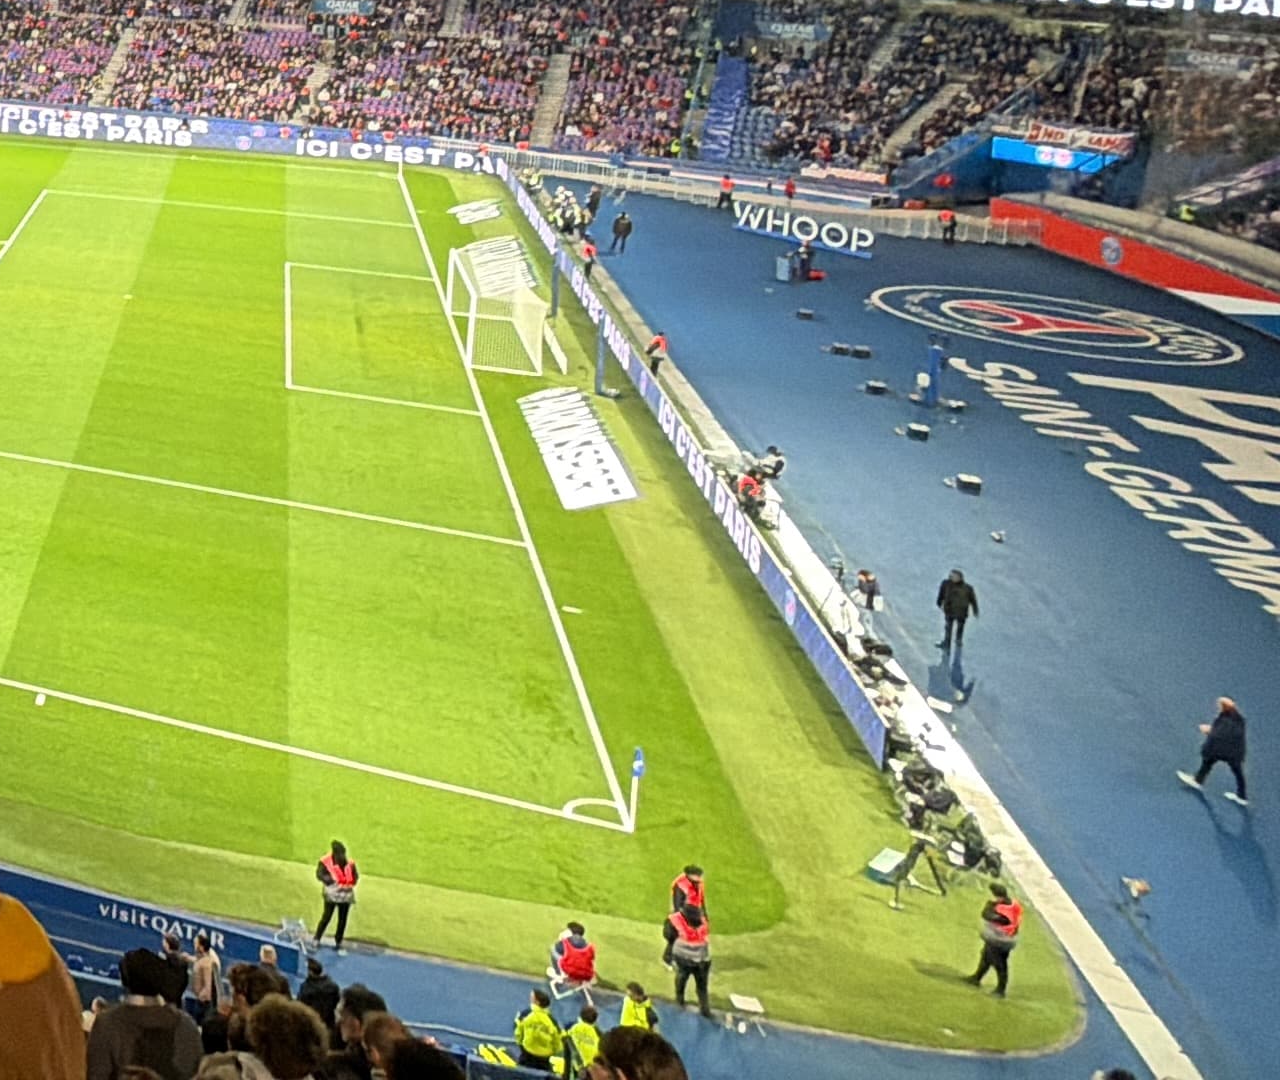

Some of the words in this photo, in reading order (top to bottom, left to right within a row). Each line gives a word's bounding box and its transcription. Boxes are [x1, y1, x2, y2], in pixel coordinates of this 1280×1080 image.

[19, 119, 96, 139] C'EST
[107, 126, 193, 147] PARIS
[296, 139, 338, 158] ICI
[350, 142, 445, 166] C'EST
[733, 201, 875, 253] WHOOP
[658, 395, 676, 442] ICI
[675, 426, 715, 500] C'EST
[714, 482, 762, 575] PARIS
